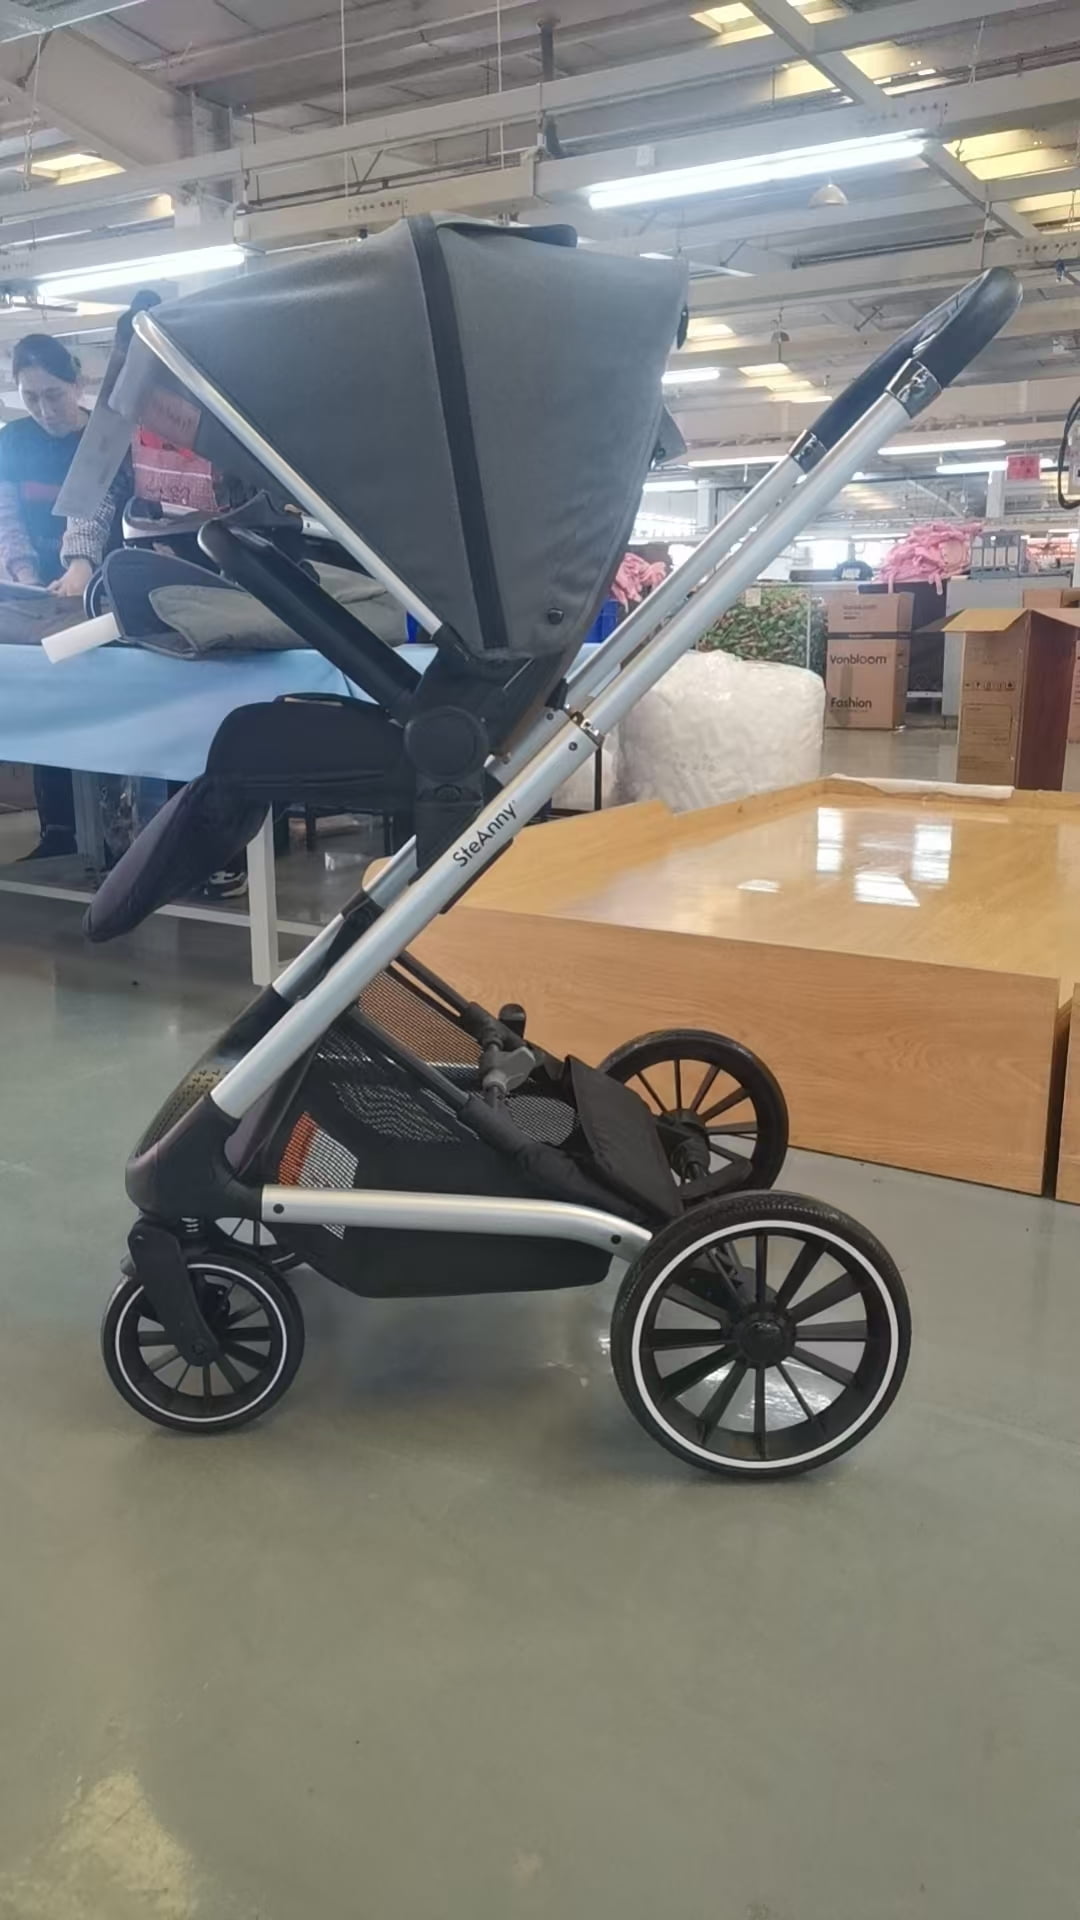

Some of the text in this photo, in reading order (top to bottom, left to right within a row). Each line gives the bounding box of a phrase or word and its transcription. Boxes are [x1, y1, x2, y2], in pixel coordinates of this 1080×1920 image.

[830, 653, 888, 665] Vonbloom
[831, 696, 872, 708] Fashion
[453, 803, 517, 867] SteAnny
